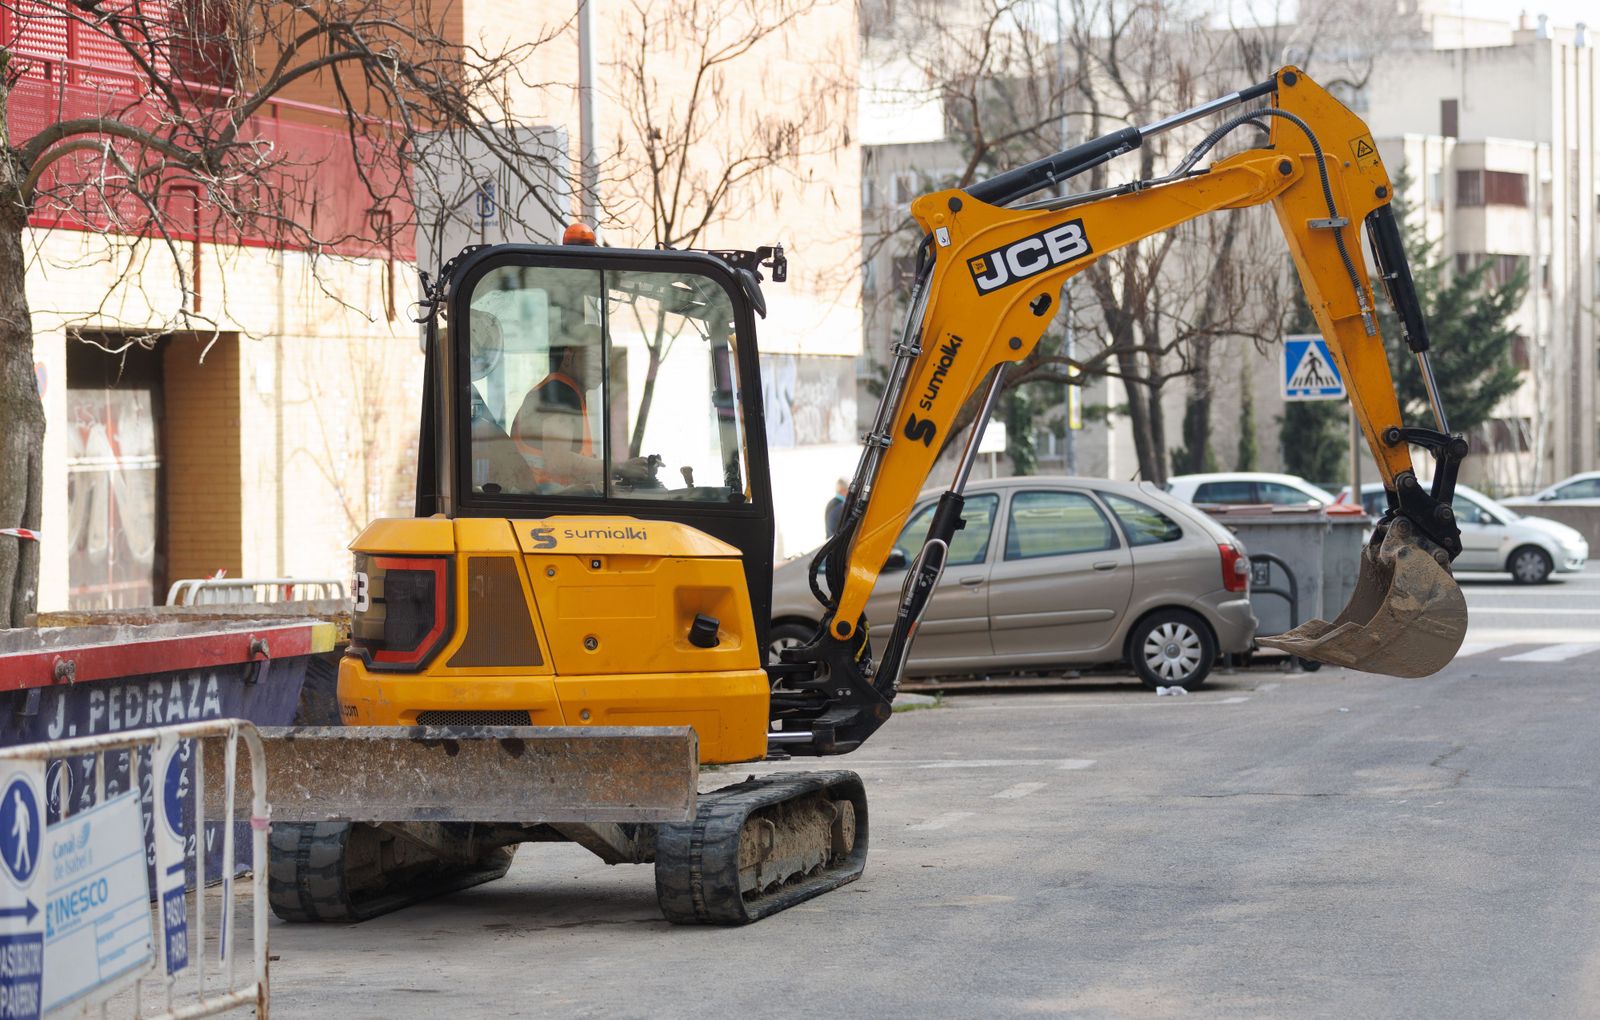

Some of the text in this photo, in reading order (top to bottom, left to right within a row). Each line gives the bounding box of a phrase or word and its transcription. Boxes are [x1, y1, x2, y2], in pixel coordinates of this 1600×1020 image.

[976, 223, 1088, 290] JCB
[919, 332, 964, 411] sumialki
[564, 526, 648, 540] sumialki
[48, 672, 221, 739] J. PEDRAZA
[55, 877, 108, 925] INESCO
